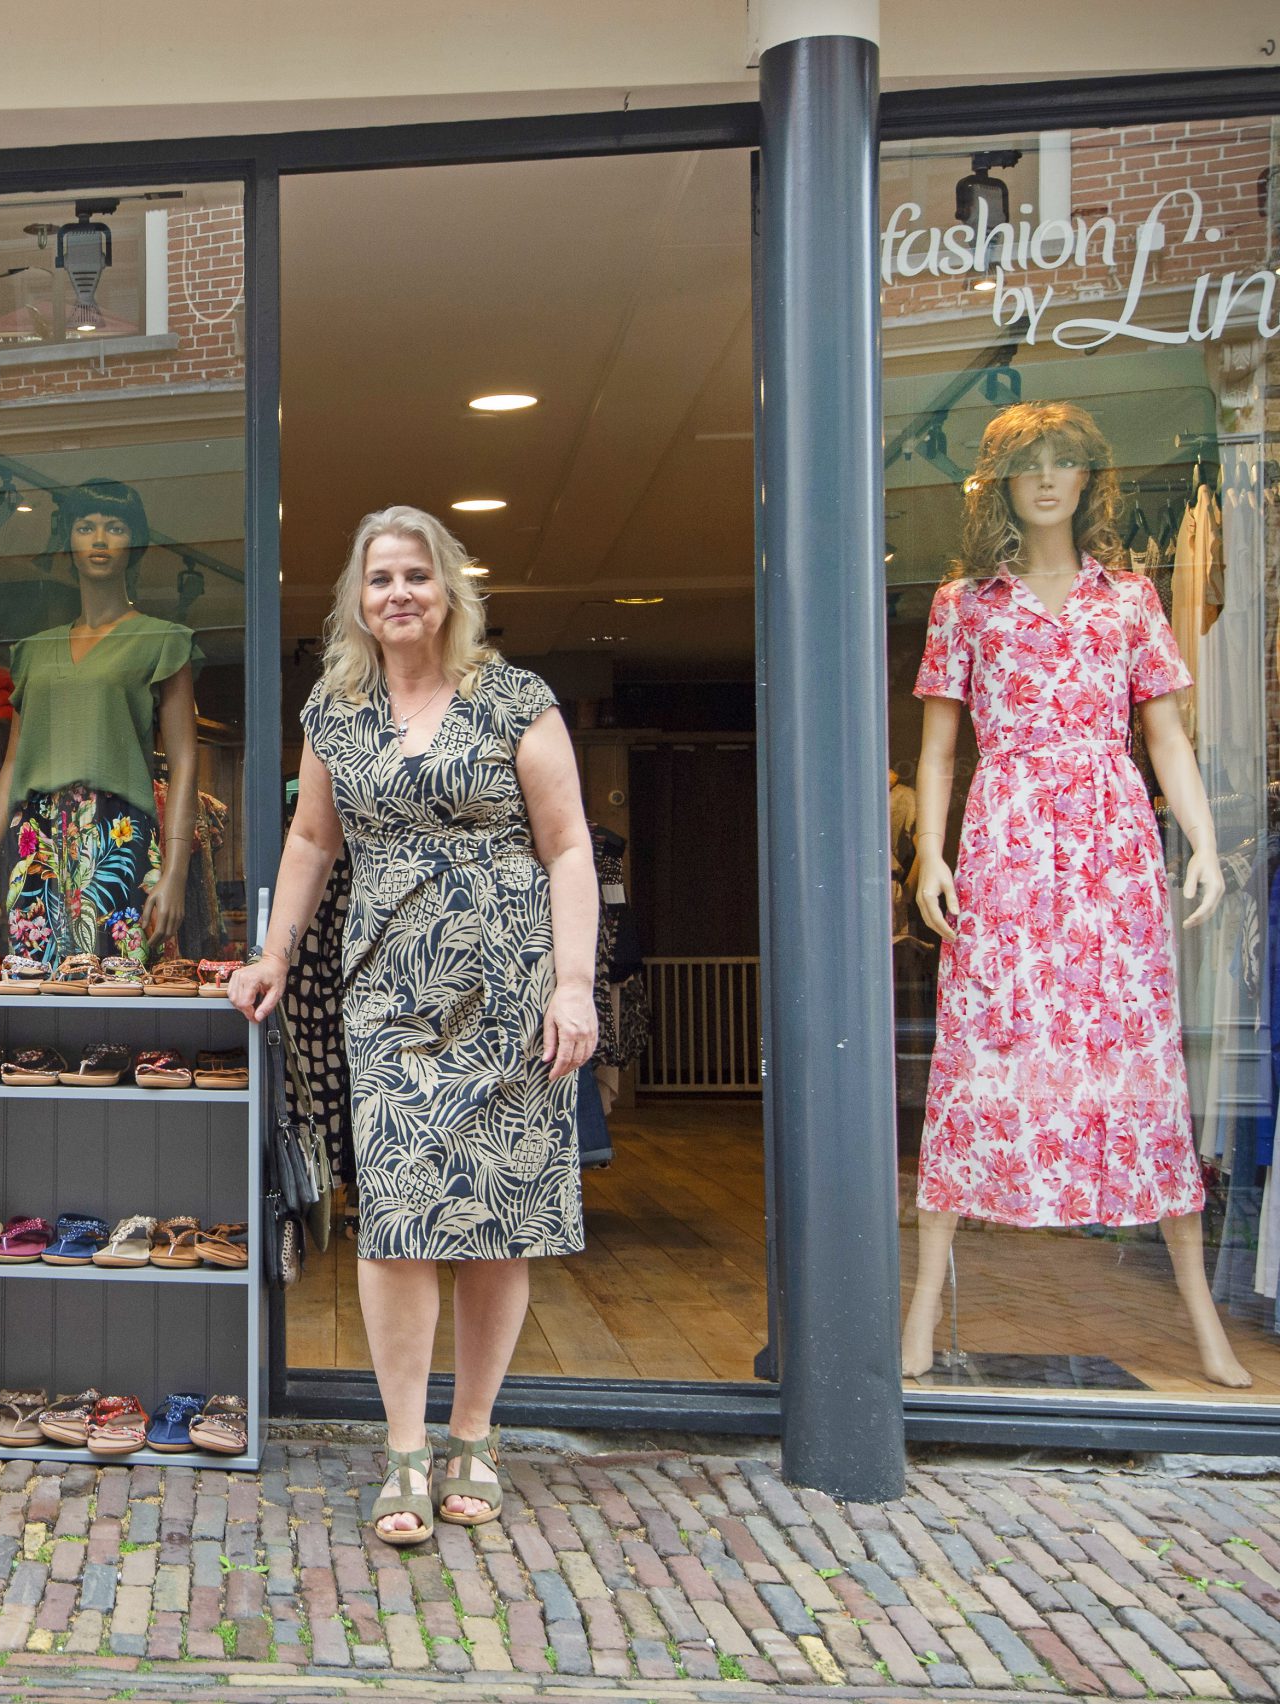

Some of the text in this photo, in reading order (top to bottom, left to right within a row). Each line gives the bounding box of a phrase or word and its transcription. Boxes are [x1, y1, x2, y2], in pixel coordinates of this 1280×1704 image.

[881, 197, 1117, 286] fashion
[993, 188, 1280, 349] by Lin
